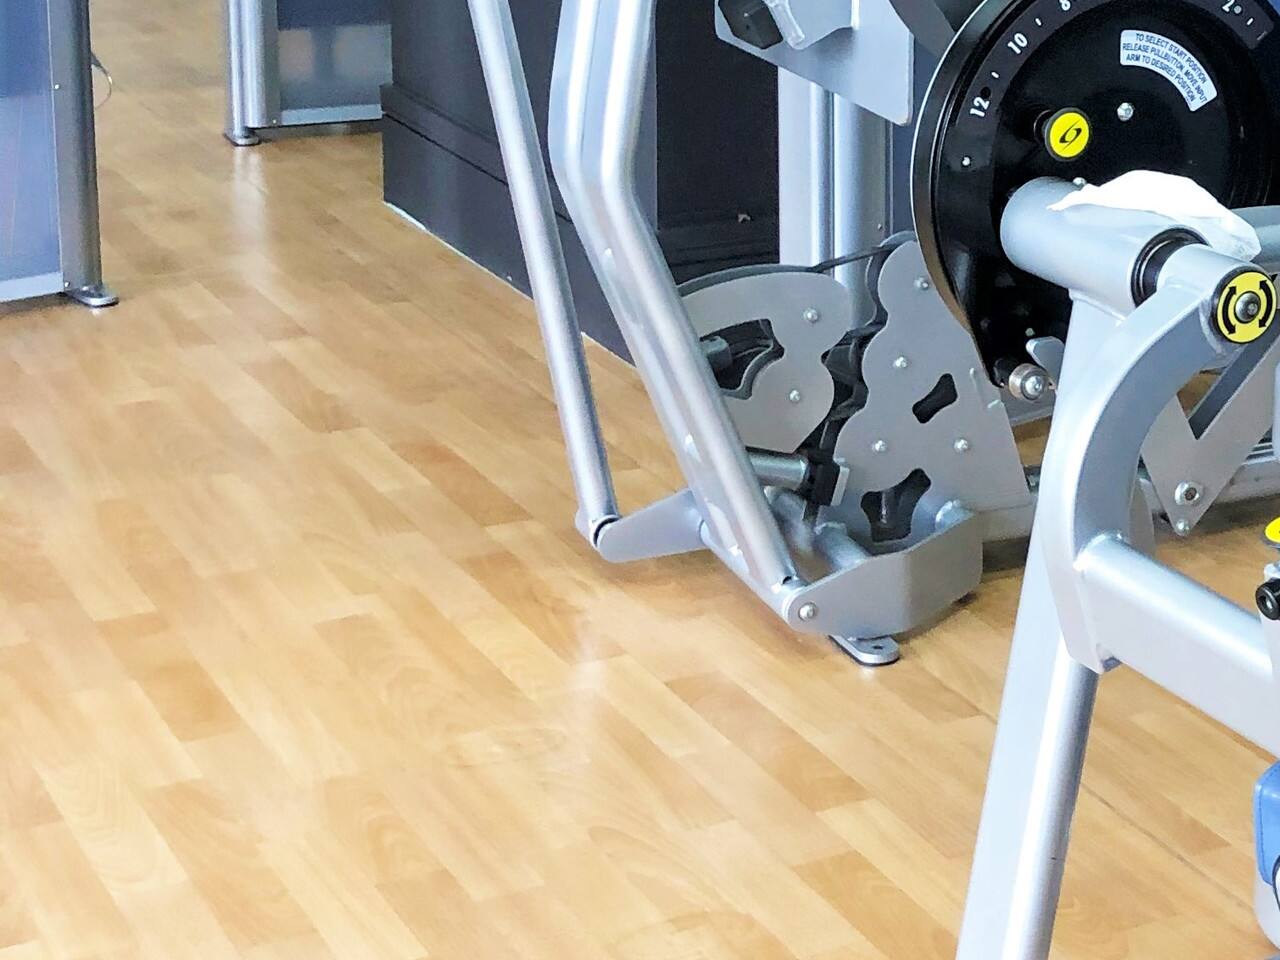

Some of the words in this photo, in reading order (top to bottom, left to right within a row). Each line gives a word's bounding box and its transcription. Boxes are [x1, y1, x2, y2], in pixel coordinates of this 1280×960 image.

[1007, 32, 1028, 55] 10
[1136, 32, 1144, 42] TO
[1146, 34, 1168, 49] SELECT
[1168, 44, 1187, 60] START
[1186, 57, 1207, 84] POSITION
[1122, 42, 1150, 54] RELEASE
[1184, 70, 1198, 86] MOVE
[1195, 84, 1208, 103] INPUT
[1126, 54, 1140, 62] ARM
[1142, 55, 1150, 64] TO
[1151, 58, 1176, 78] DESIRED
[1174, 74, 1196, 102] POSITION
[969, 96, 991, 117] 12
